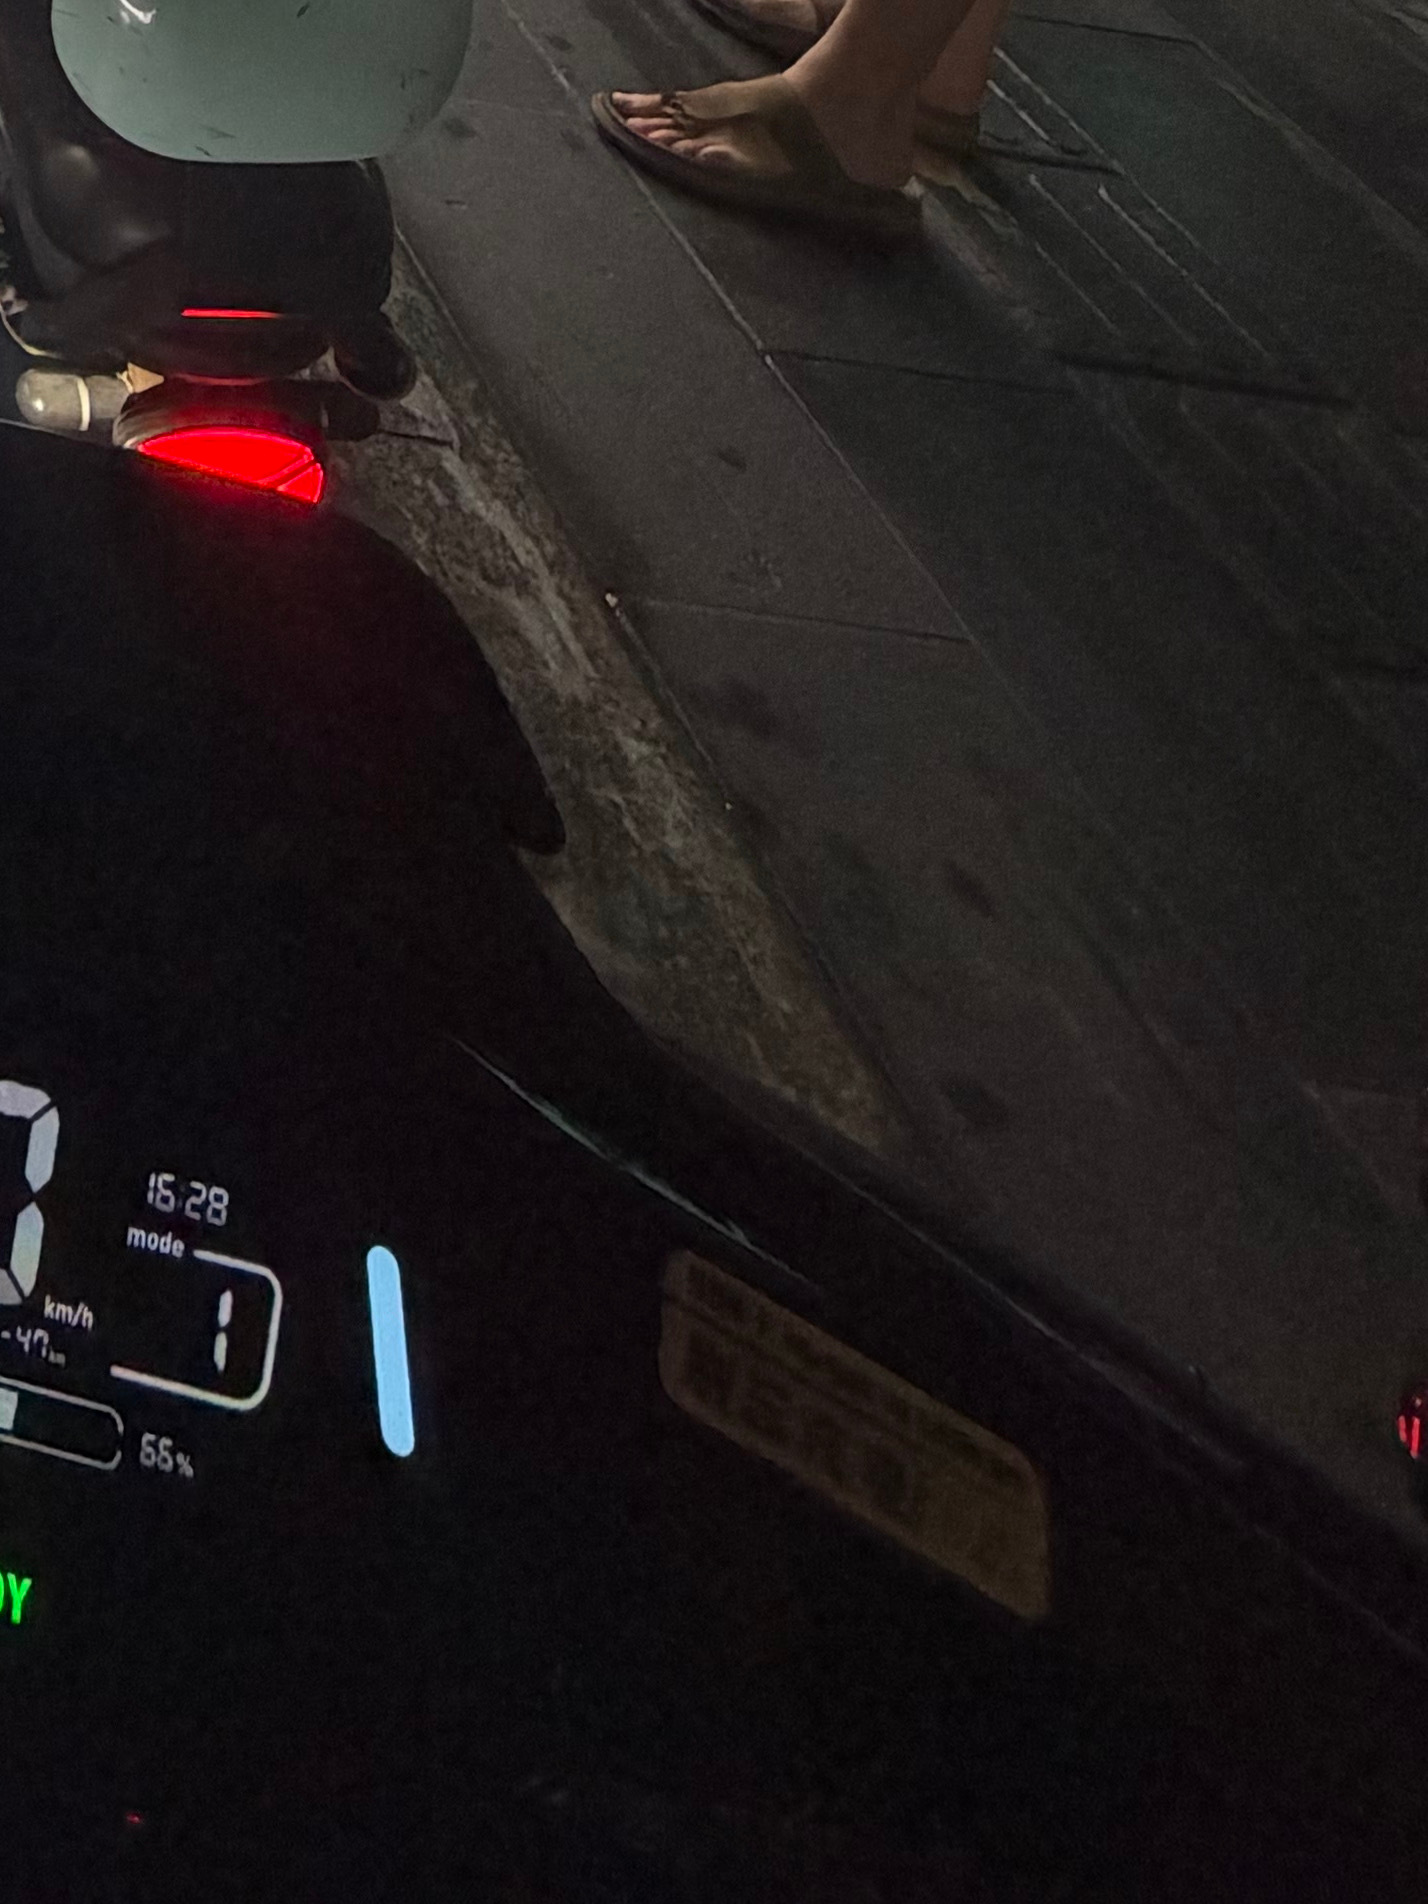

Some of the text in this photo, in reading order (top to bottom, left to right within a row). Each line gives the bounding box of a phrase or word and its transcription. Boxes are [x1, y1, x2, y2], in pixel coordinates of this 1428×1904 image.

[126, 1226, 185, 1259] mode
[44, 1294, 94, 1331] km/h
[213, 1288, 235, 1374] 1
